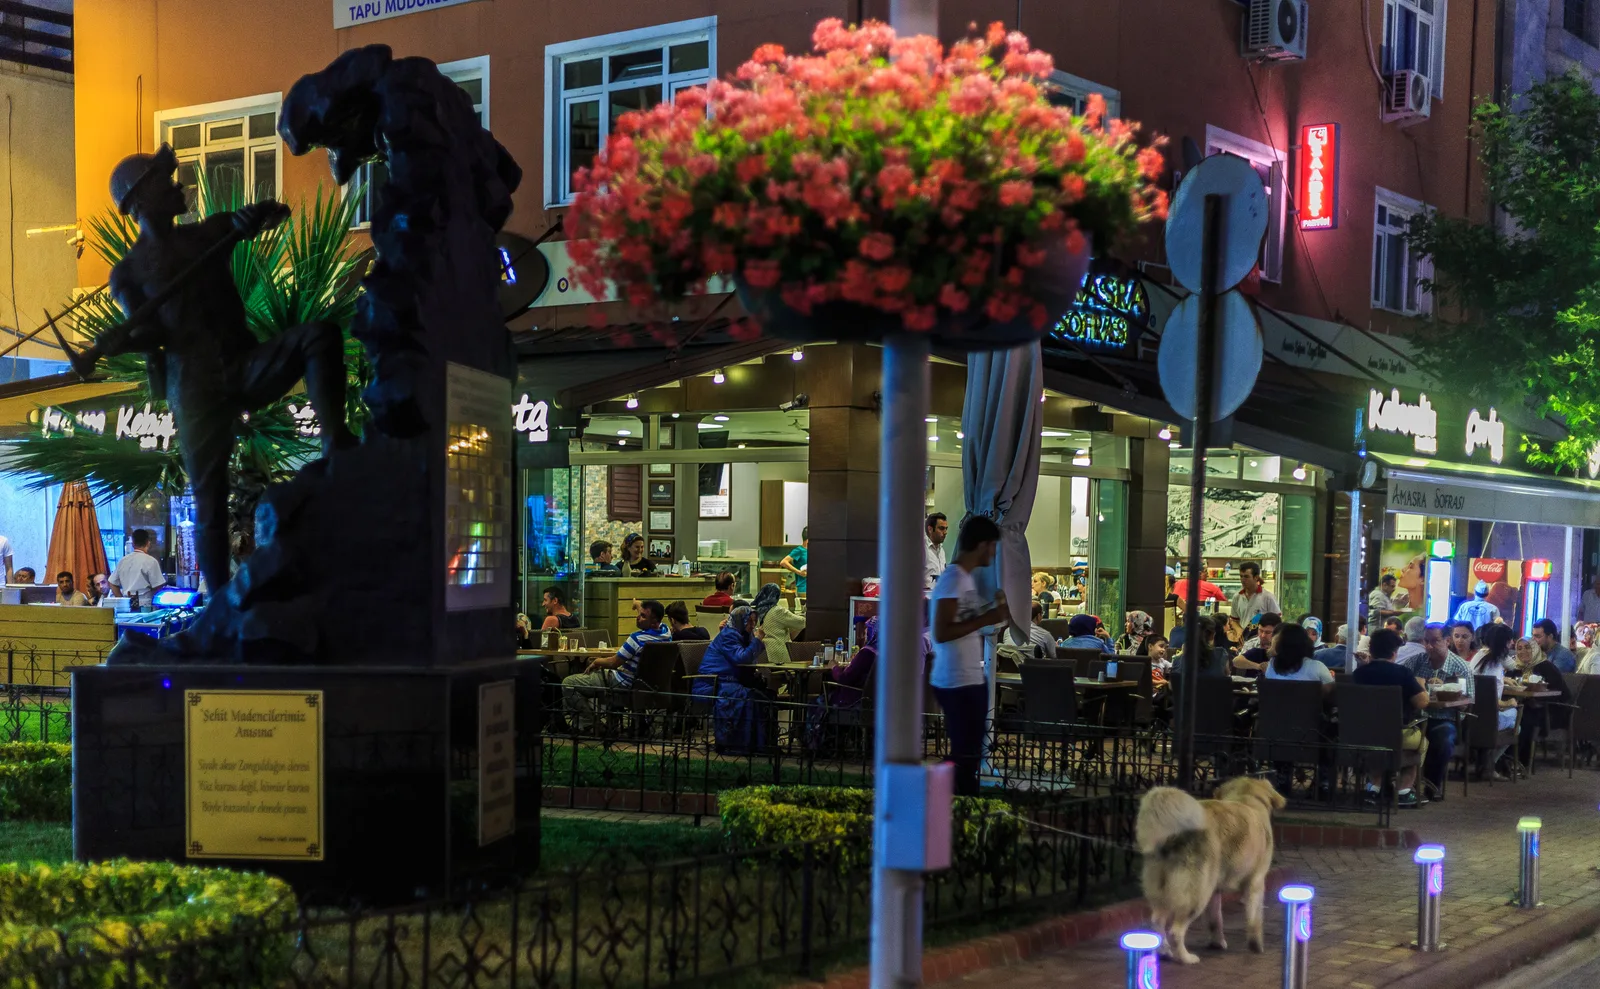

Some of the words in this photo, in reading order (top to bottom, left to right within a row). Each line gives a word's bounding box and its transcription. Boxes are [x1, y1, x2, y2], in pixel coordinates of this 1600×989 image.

[349, 1, 380, 21] TAPU
[1392, 483, 1427, 508] AMASRA
[1434, 488, 1465, 510] SOFRASI
[231, 708, 306, 722] Madencilerimiz
